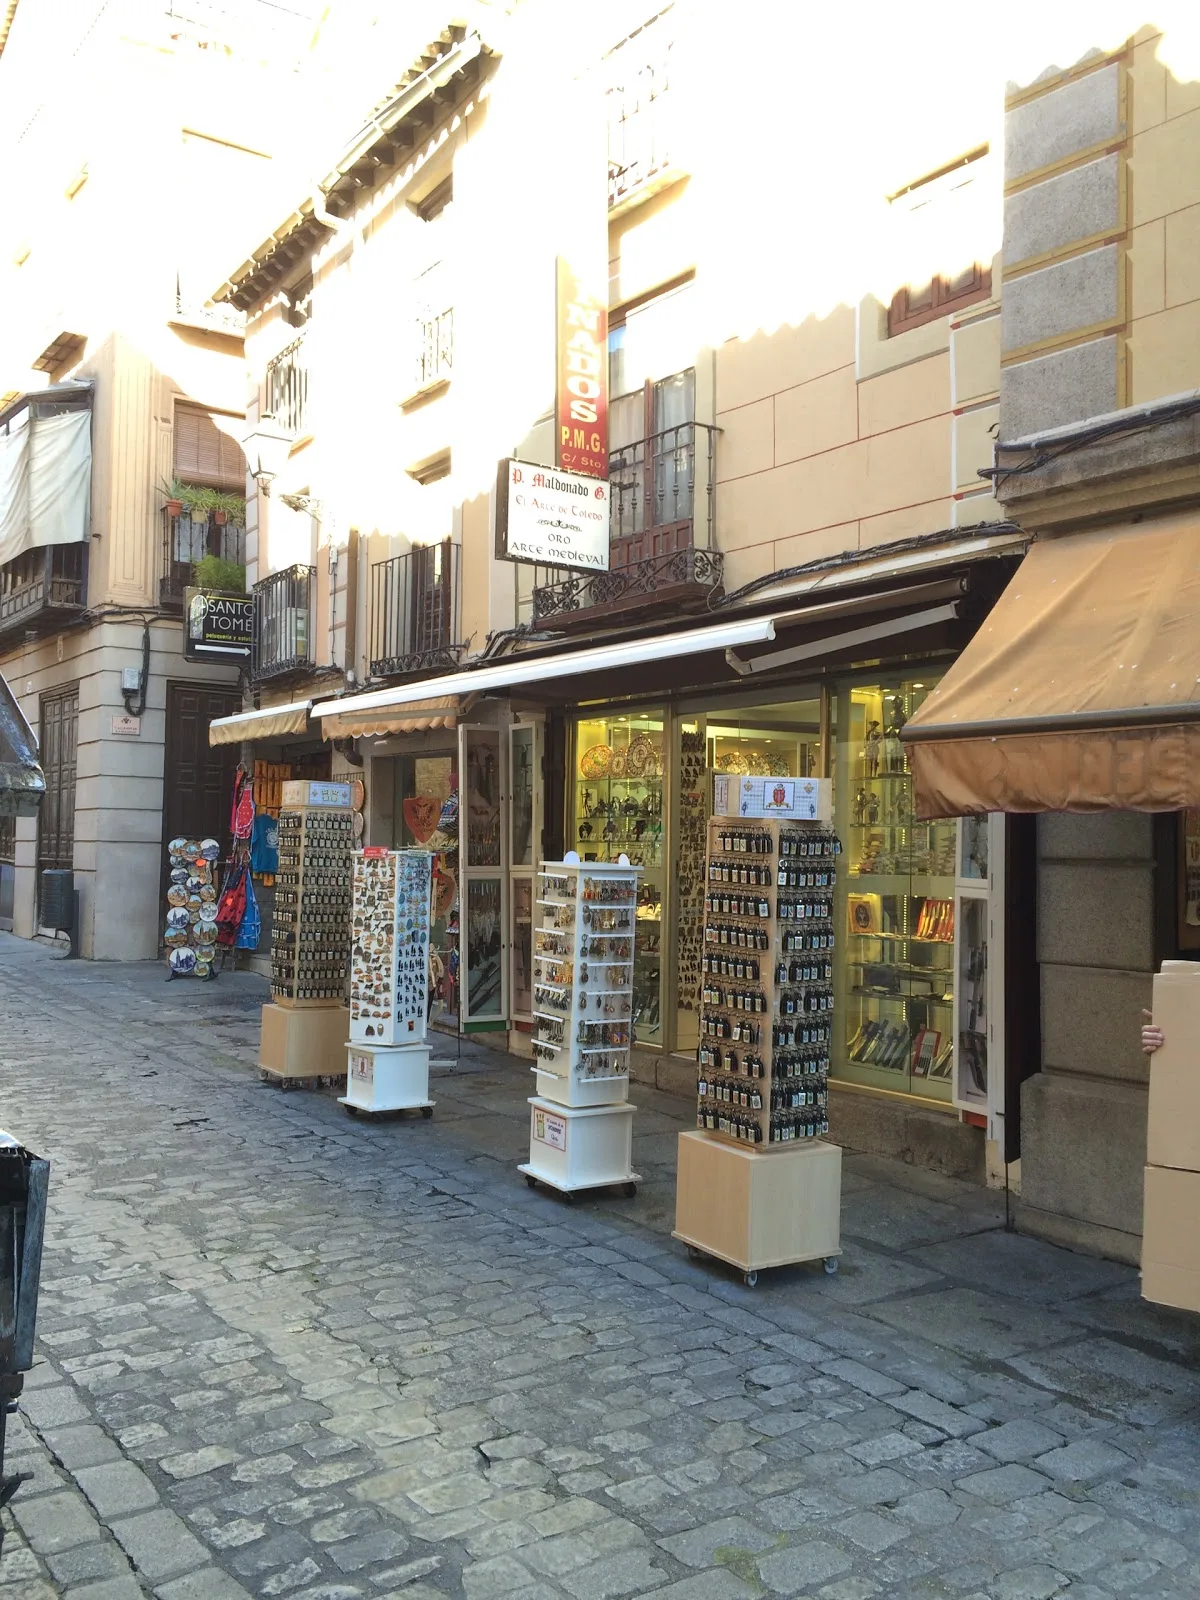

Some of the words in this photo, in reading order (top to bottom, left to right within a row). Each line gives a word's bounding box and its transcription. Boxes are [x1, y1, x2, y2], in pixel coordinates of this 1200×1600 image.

[561, 425, 605, 454] P.M.G.
[562, 452, 577, 463] C/
[580, 456, 605, 469] Sto.
[512, 467, 525, 485] P.
[531, 472, 589, 497] Maldonado
[547, 533, 571, 545] ORO
[208, 599, 256, 617] SANTO
[209, 615, 253, 632] TOMÉ
